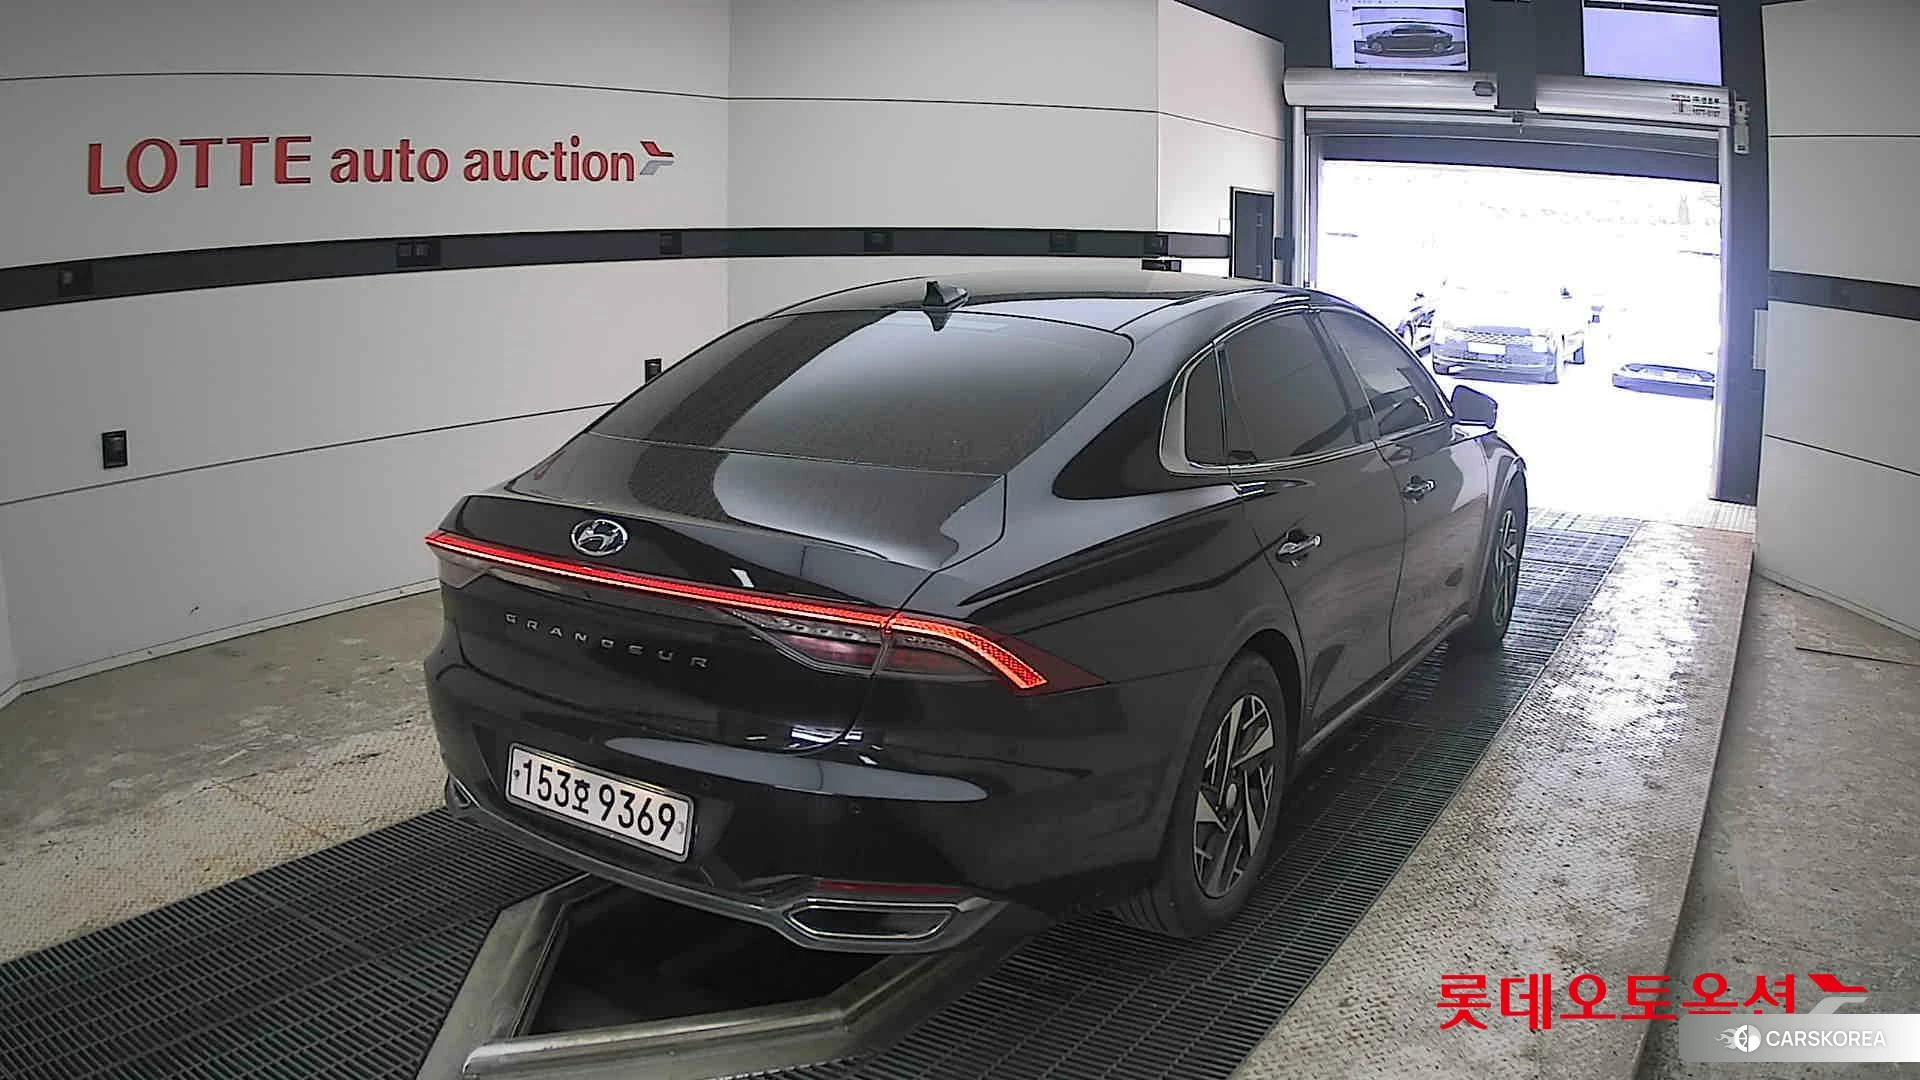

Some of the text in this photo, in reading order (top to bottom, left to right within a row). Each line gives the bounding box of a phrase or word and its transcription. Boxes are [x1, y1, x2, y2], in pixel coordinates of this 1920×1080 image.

[88, 135, 637, 195] LOTTE auto auction
[505, 613, 709, 669] GRANDEUR
